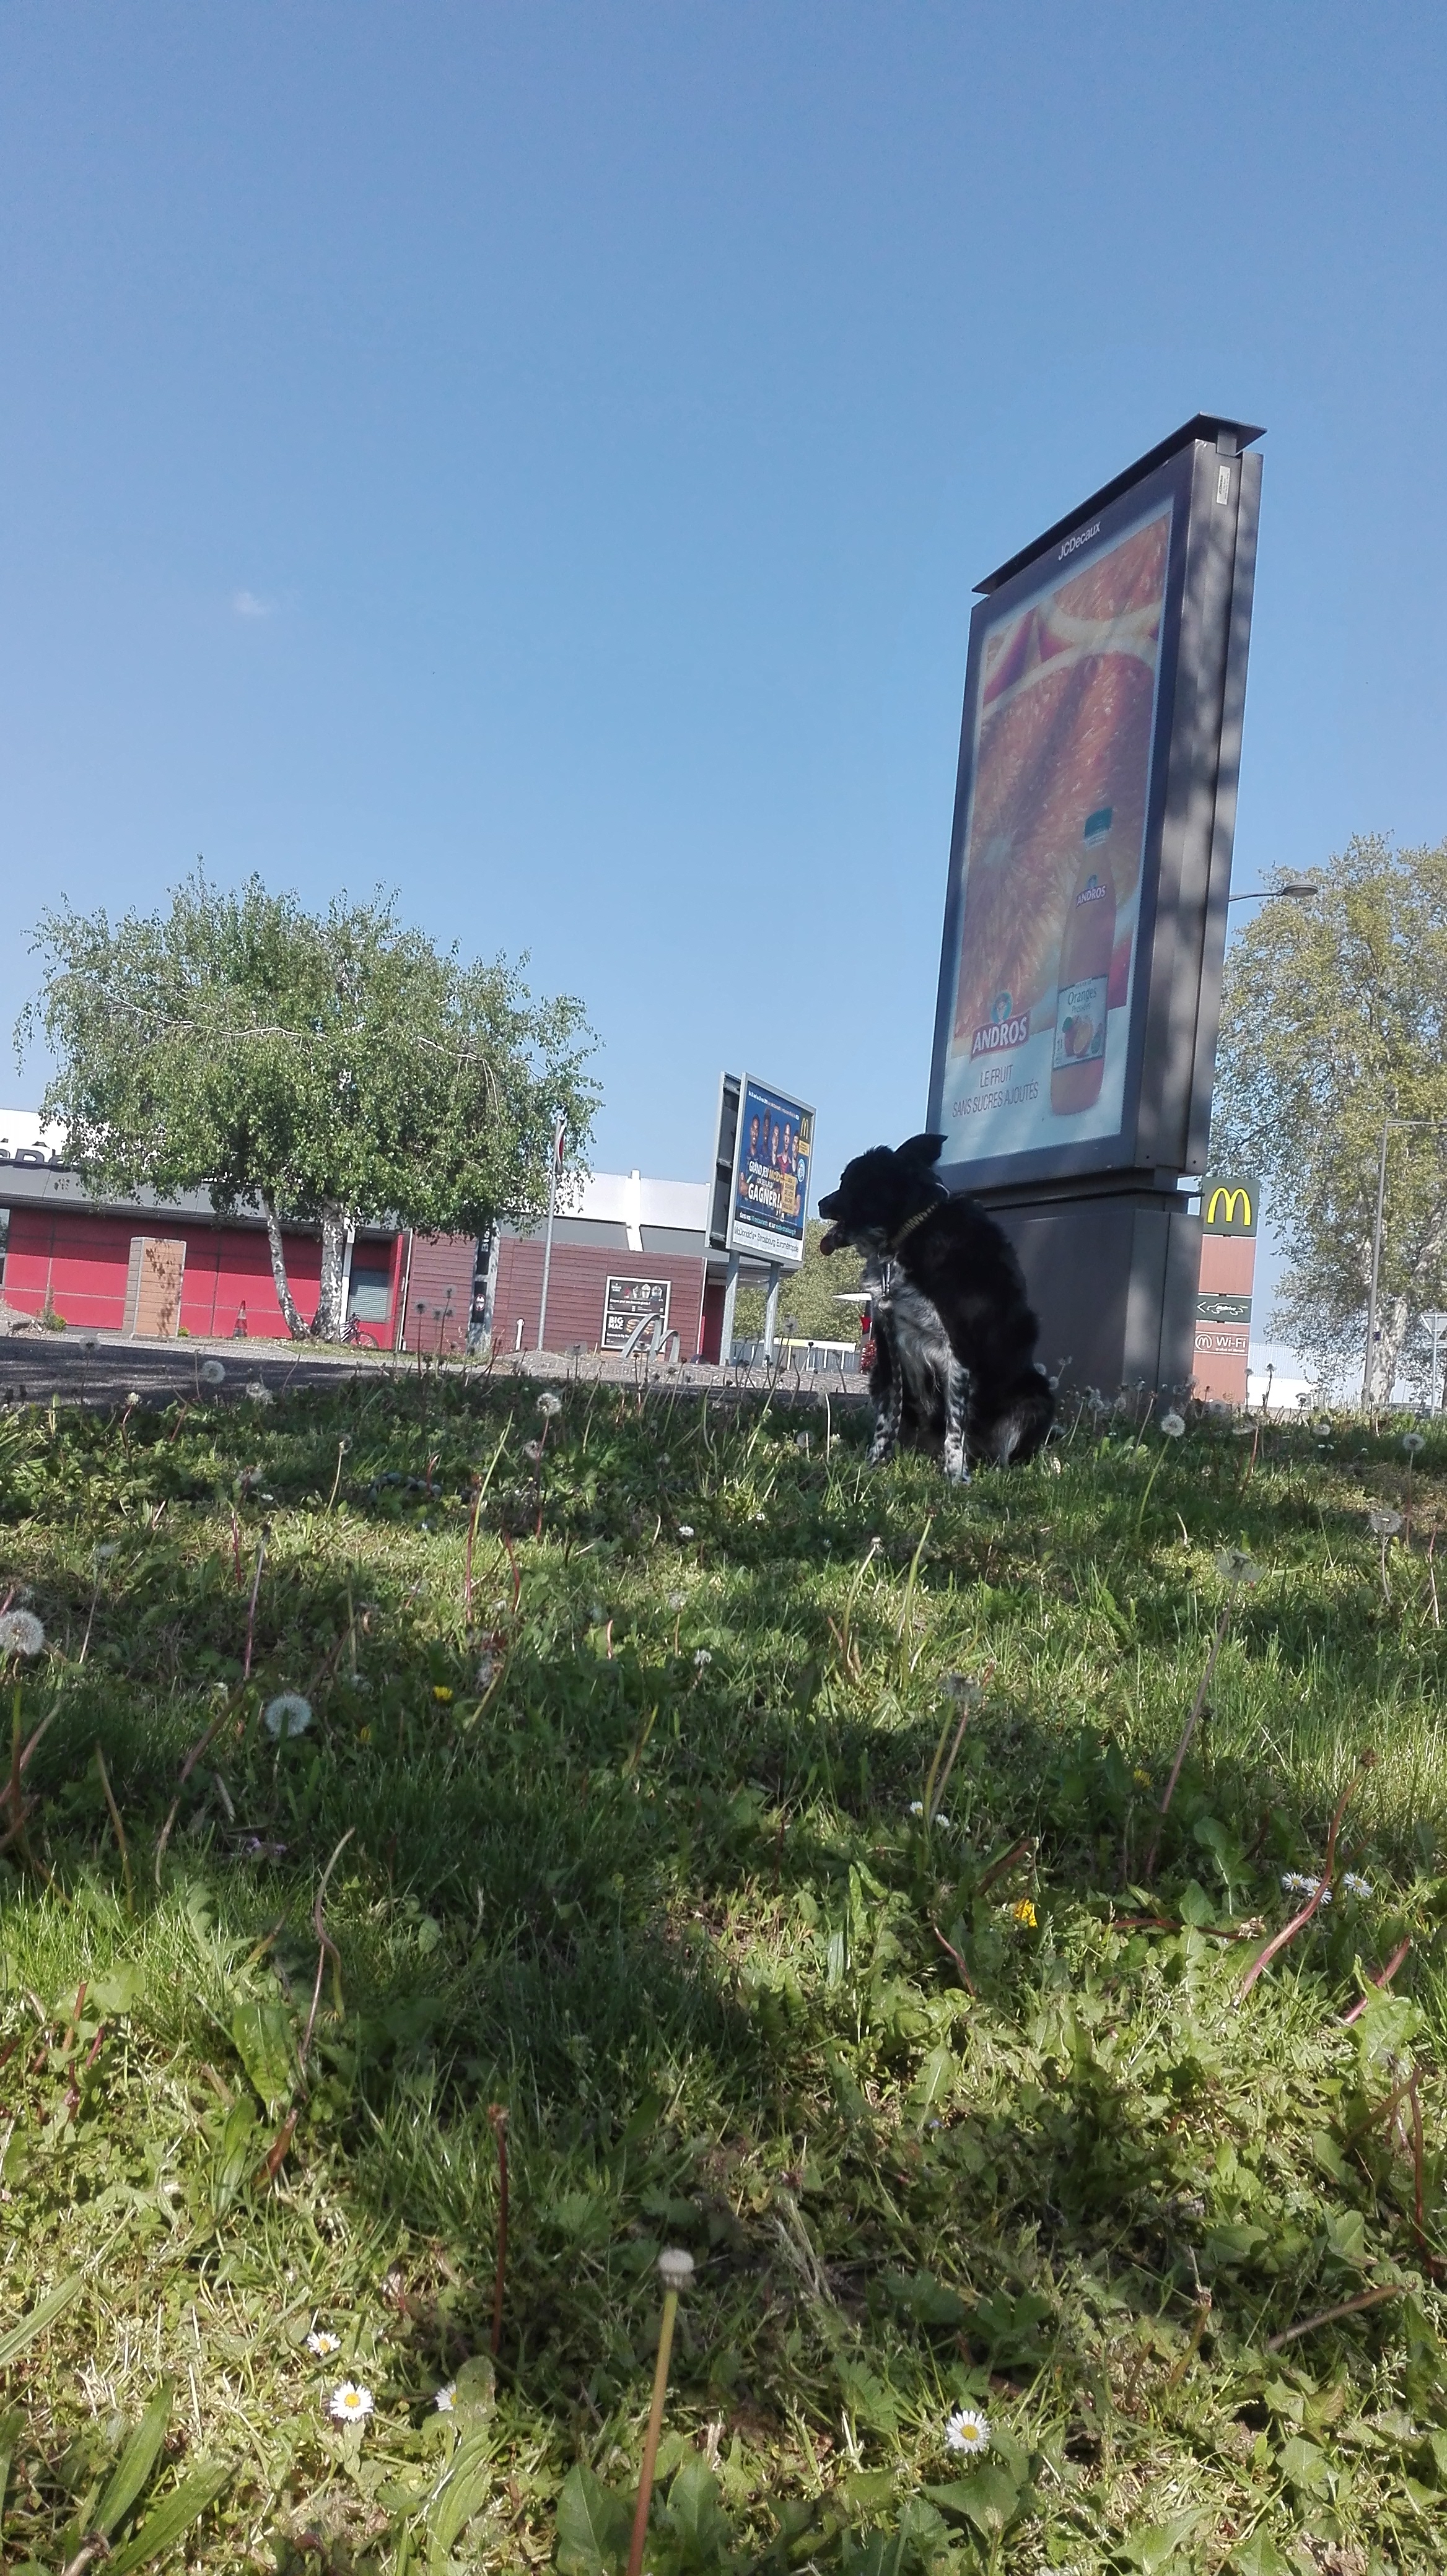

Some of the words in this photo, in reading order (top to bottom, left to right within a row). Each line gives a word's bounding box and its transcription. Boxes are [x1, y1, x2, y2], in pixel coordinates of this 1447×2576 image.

[1058, 521, 1101, 561] JCDecaux
[1077, 885, 1106, 905] ANDROS
[1068, 987, 1097, 1005] Oranges
[973, 1016, 1027, 1054] ANDROS
[980, 1071, 989, 1088] LE
[991, 1064, 1013, 1086] FRUIT
[952, 1098, 971, 1118] SANS
[973, 1090, 1003, 1113] SUCRES
[1005, 1079, 1039, 1106] AJOUTÉS
[749, 1160, 762, 1176] GRAND
[609, 1316, 624, 1324] BIG
[1216, 1336, 1246, 1348] Wi-Fi
